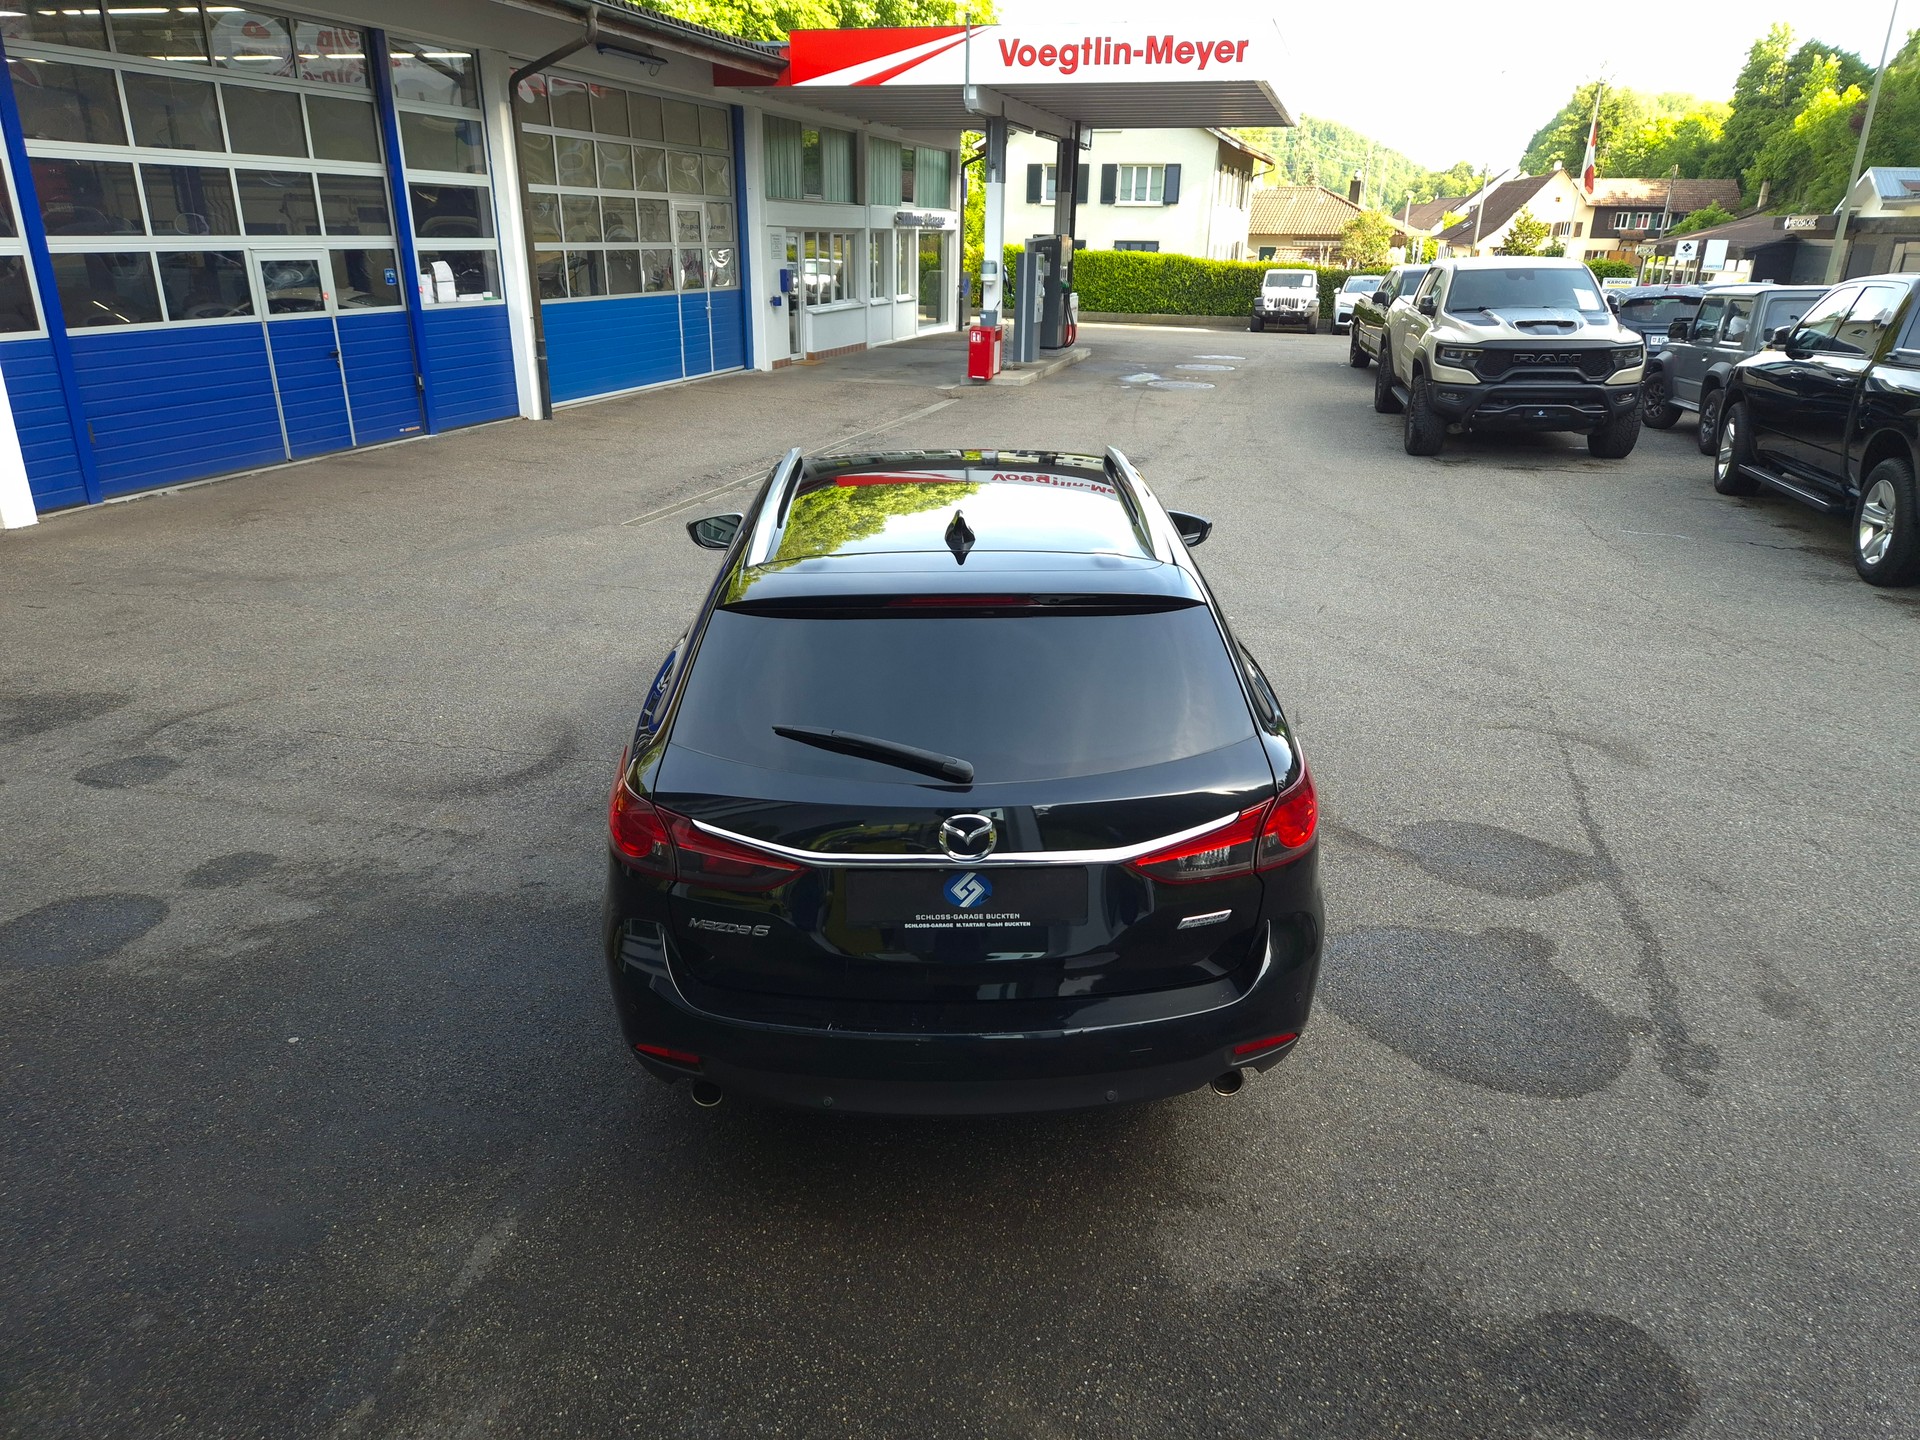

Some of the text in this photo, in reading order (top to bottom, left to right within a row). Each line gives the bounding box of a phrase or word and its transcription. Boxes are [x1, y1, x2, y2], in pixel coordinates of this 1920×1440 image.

[998, 35, 1249, 75] Voegtlin-Meyer
[1513, 354, 1582, 363] RAM
[915, 913, 984, 921] SCHLOSS-GARAGE
